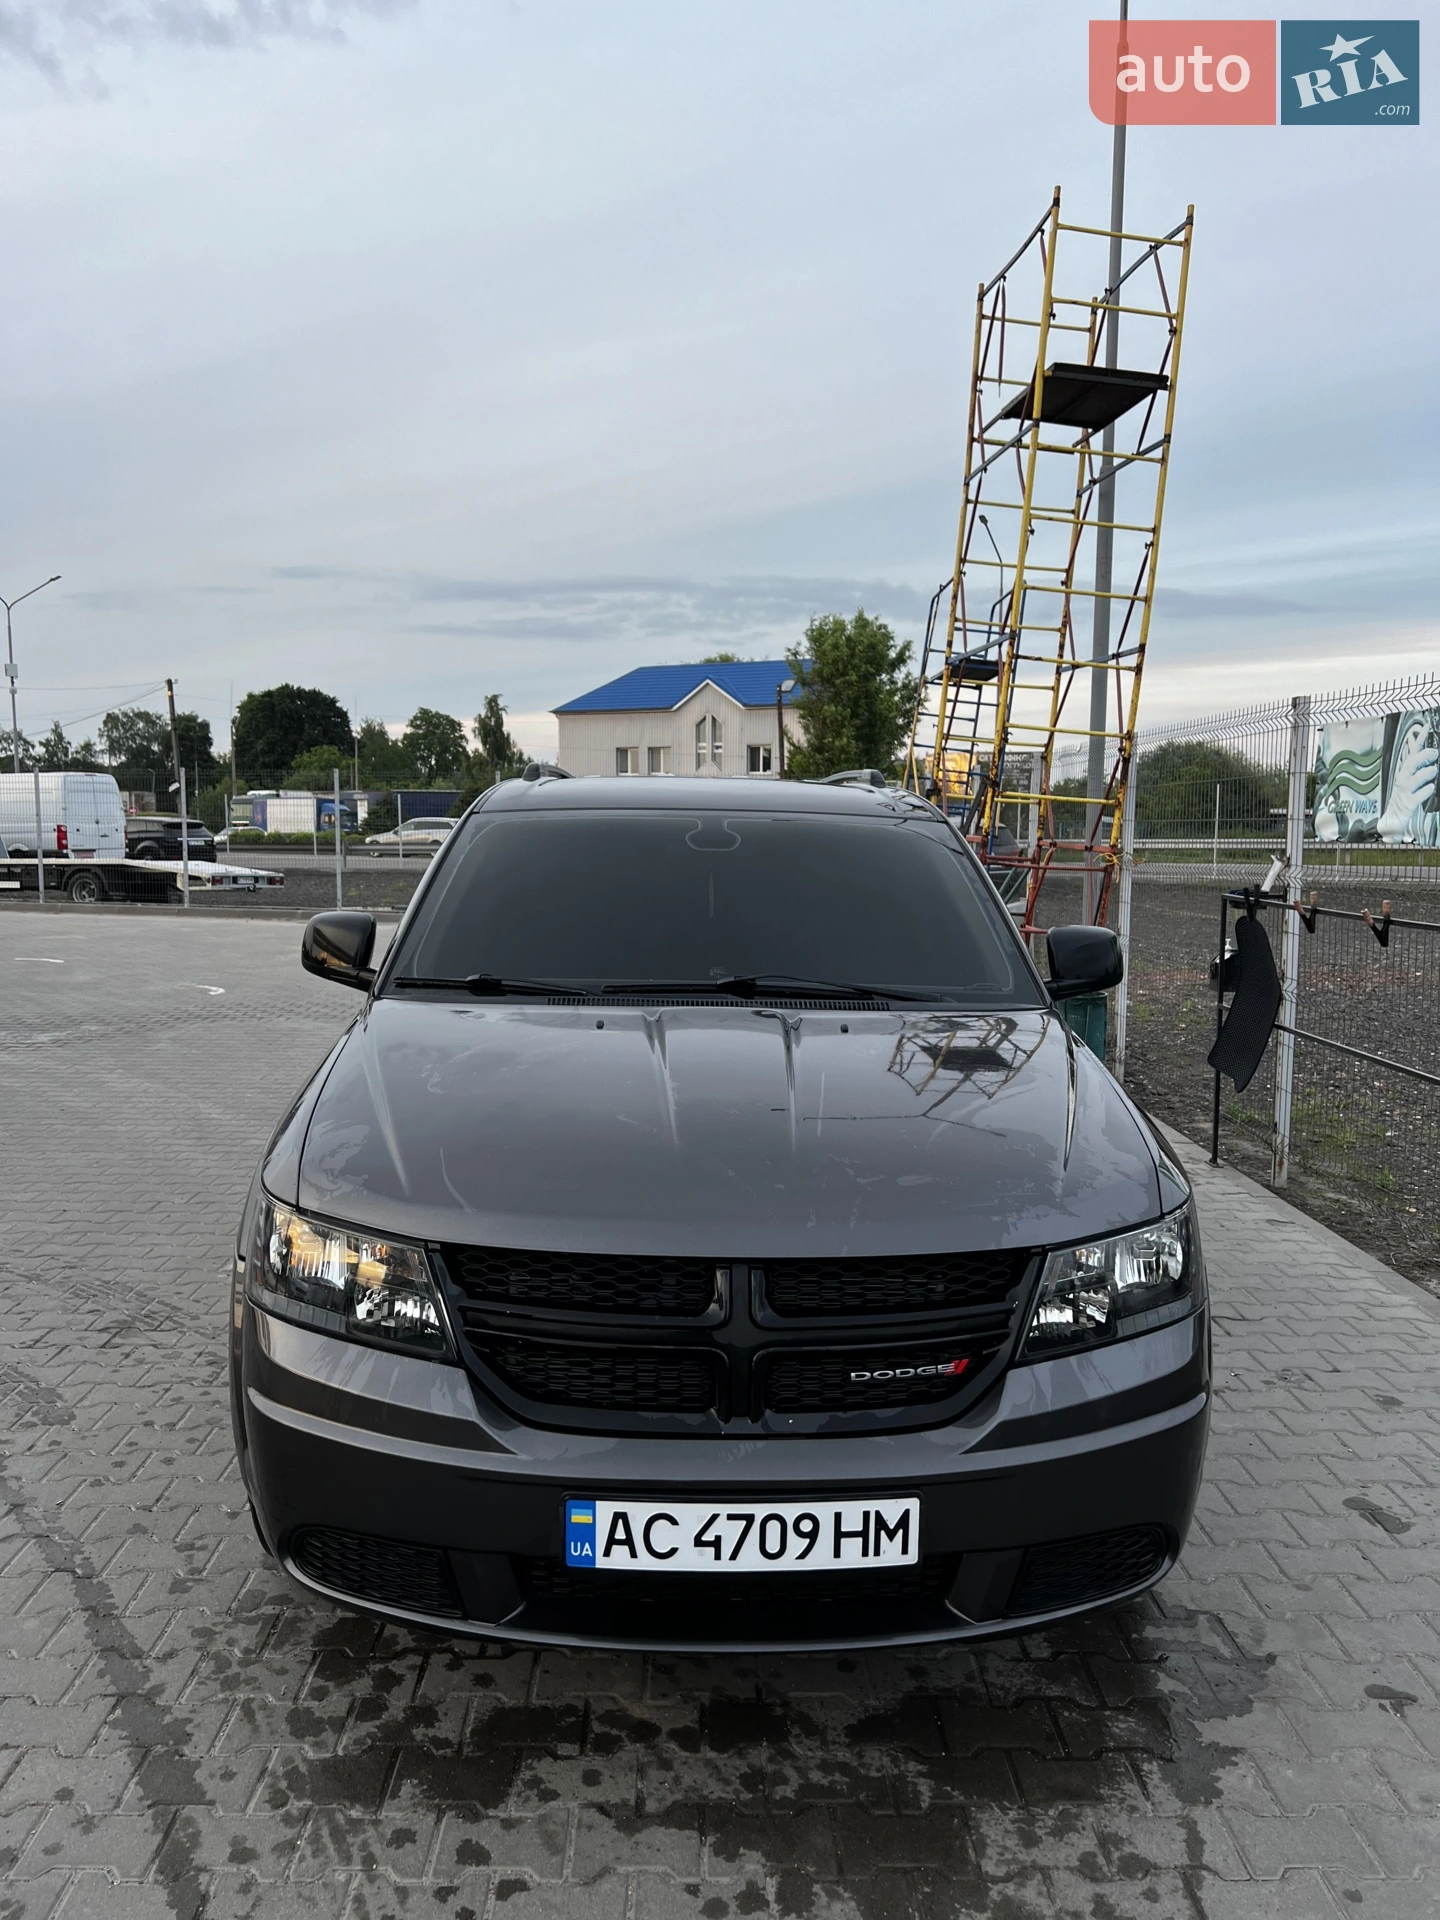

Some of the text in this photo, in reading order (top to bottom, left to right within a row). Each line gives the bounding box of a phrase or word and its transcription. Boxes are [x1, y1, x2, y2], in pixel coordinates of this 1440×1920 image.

[1327, 800, 1378, 814] GREEN WAVE
[850, 1362, 956, 1381] DODGE
[602, 1508, 911, 1561] AC 4709 HM
[570, 1541, 593, 1557] UA
